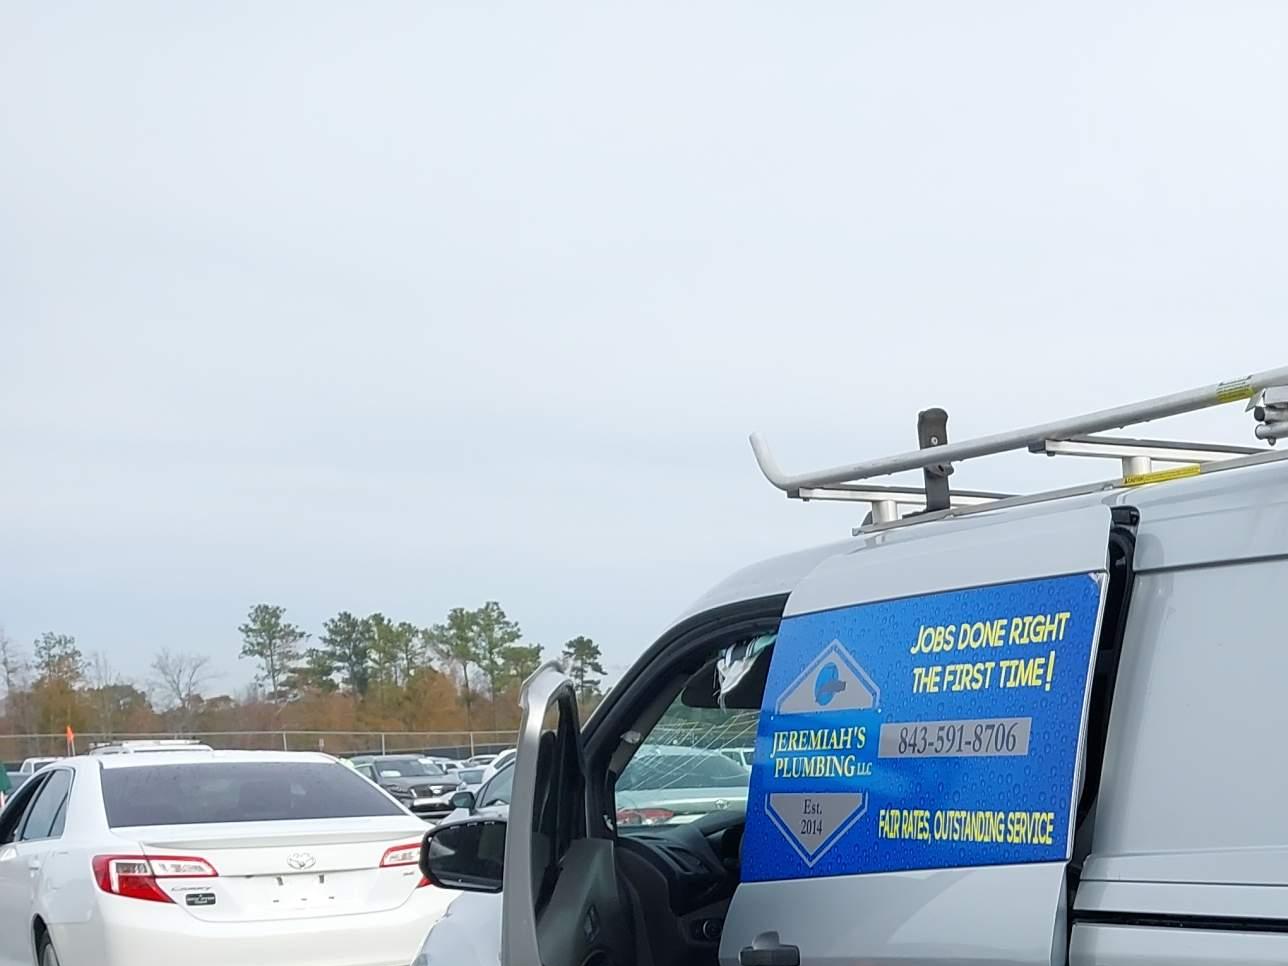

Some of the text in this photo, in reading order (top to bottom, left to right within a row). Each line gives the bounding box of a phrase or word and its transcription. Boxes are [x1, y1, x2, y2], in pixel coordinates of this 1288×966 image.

[910, 612, 1071, 654] JOBS DONE RIGHT
[912, 650, 1056, 693] THE FIRST TIME!
[769, 726, 867, 758] JEREMIAH'S
[898, 722, 1018, 754] 843-591-8706
[774, 755, 873, 778] PLUMBING LLC
[803, 798, 823, 815] Est.
[800, 818, 823, 836] 2014
[878, 809, 1055, 845] FAIR RATES, OUTSTANDING SERVICE
